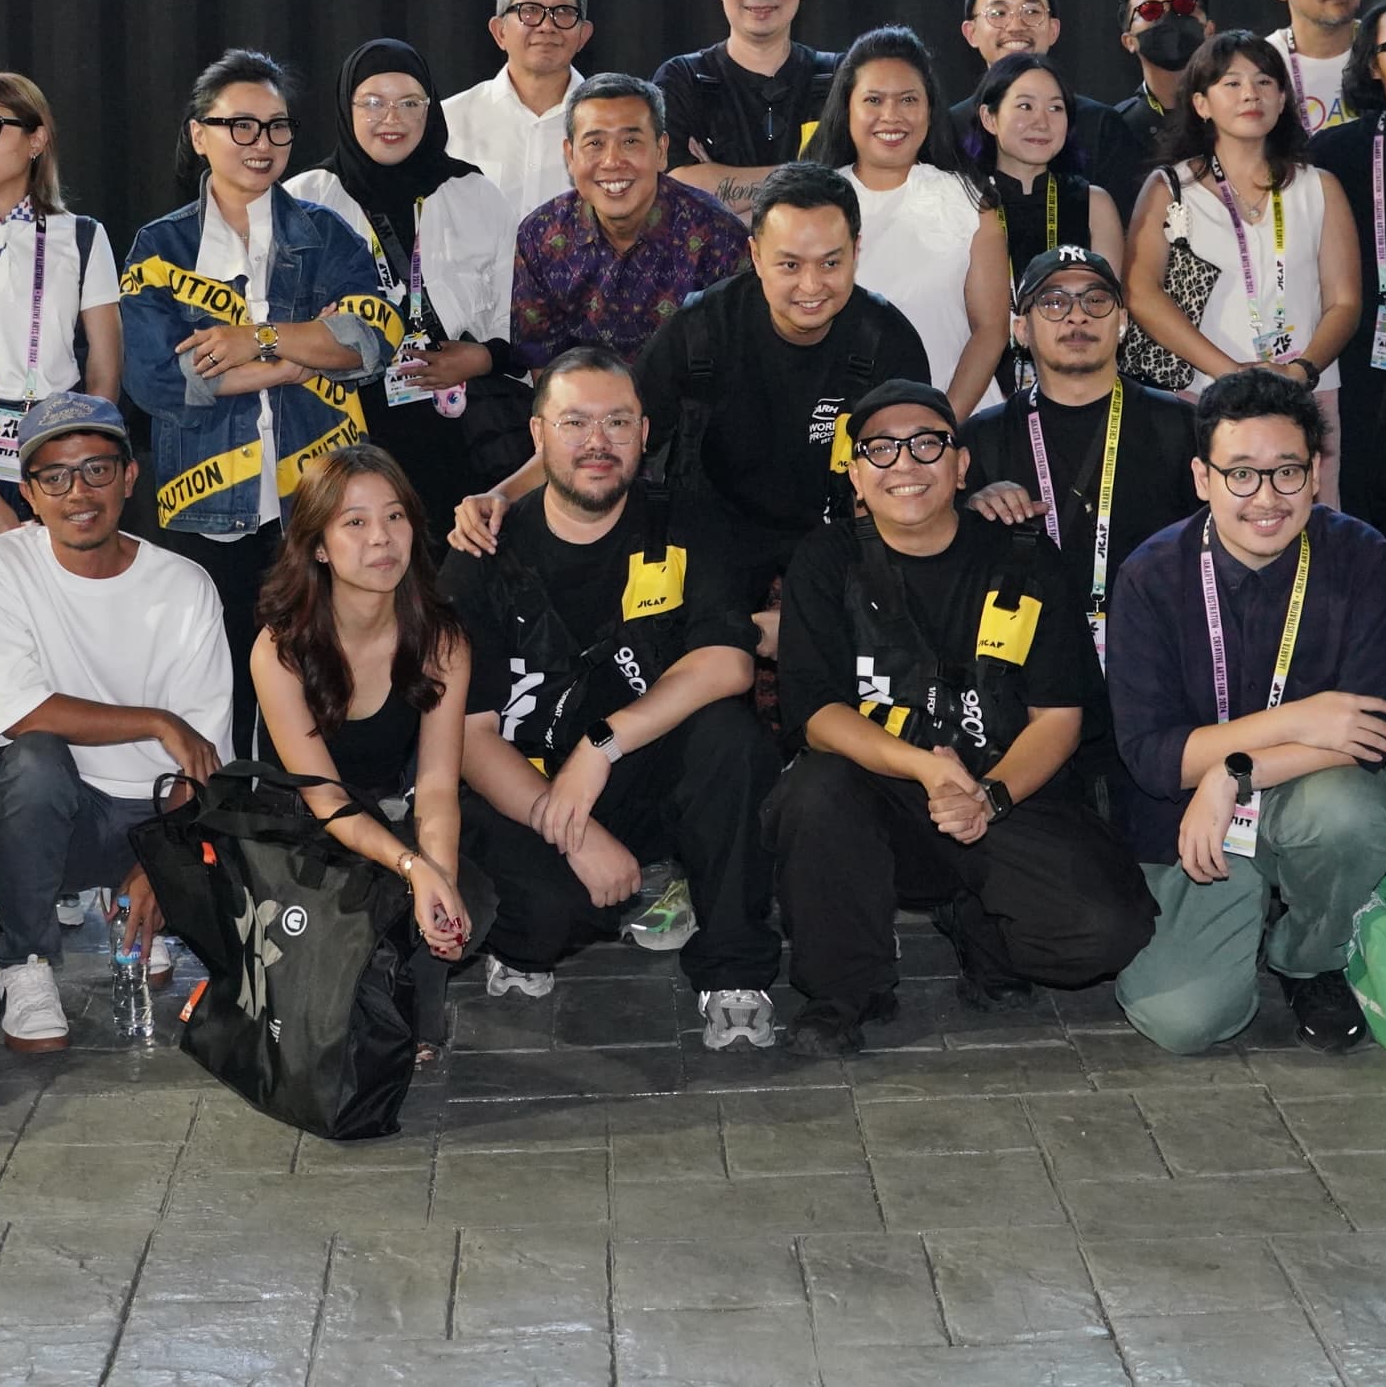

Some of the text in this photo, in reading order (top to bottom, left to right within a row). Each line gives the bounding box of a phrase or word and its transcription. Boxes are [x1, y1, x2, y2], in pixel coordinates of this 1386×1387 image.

[1276, 260, 1284, 290] JICAF
[1274, 333, 1292, 348] JIC
[1275, 343, 1290, 356] AF
[1108, 414, 1120, 441] CREATIVE
[1035, 440, 1047, 481] ILLUSTRATION
[1103, 446, 1116, 486] ILLUSTRATION
[1101, 488, 1111, 511] JAKARTA
[1097, 523, 1107, 559] JICAF
[637, 597, 667, 608] JICAF
[1279, 568, 1307, 670] JAKARTA ILLUSTRATION CREATIVE
[1203, 559, 1227, 714] JAKARTA ILLUSTRATION CREATIVE ARTS FAIR 2024
